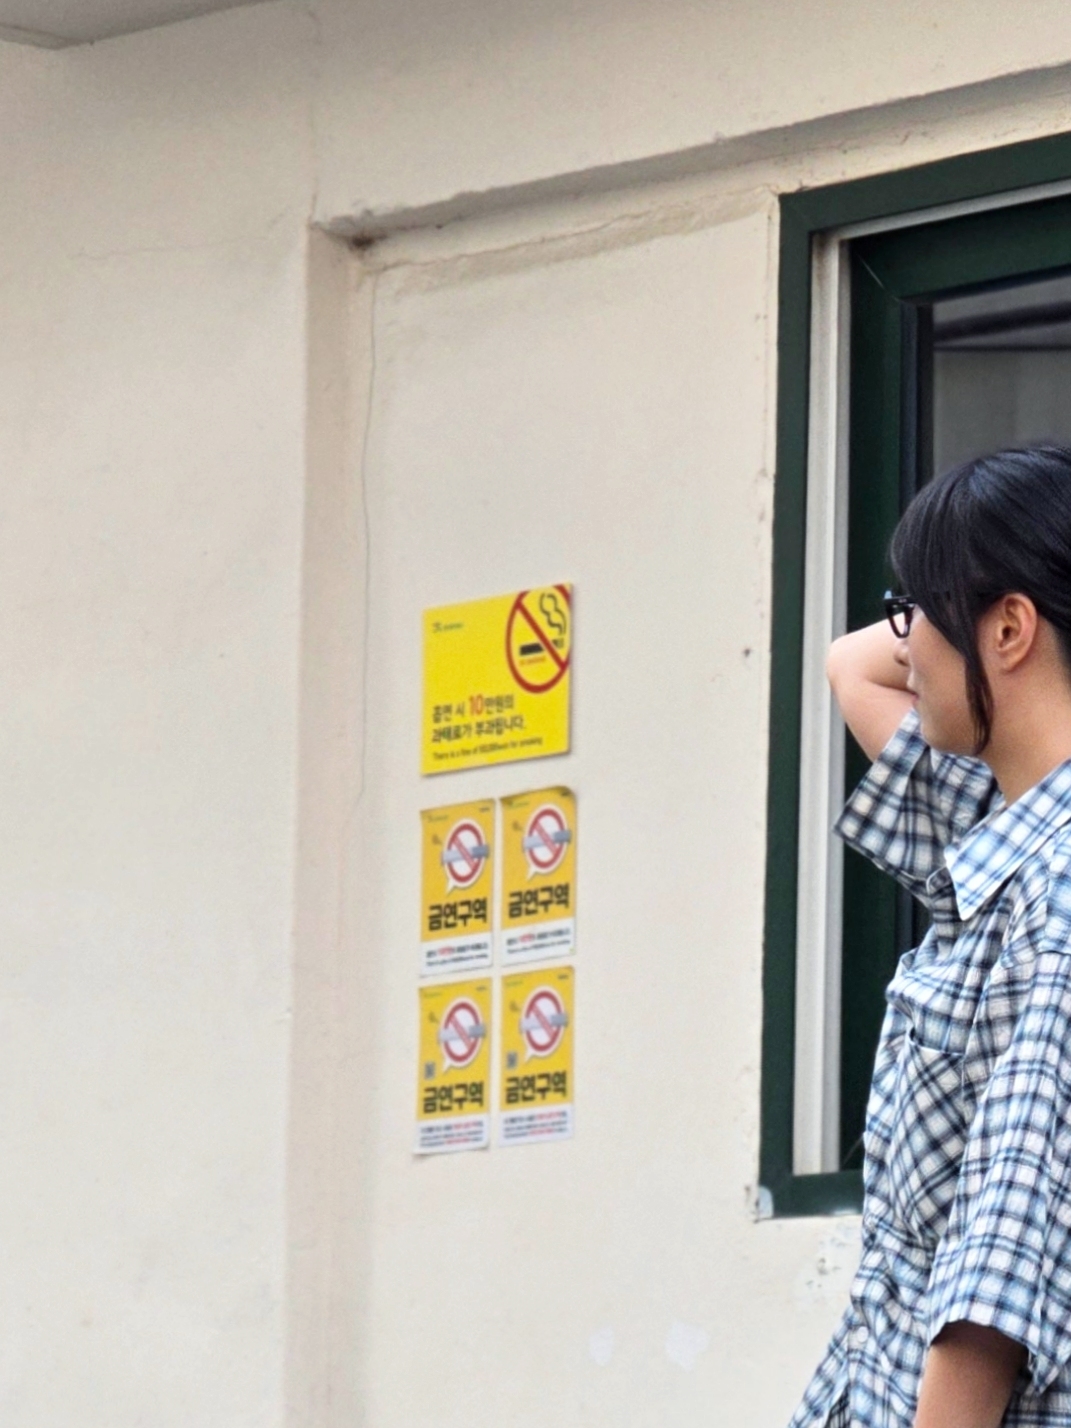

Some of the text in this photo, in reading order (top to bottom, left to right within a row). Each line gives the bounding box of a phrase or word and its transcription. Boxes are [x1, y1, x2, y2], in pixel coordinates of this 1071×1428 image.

[428, 897, 488, 931] 금연구역
[508, 882, 570, 919] 금연구역
[423, 1080, 484, 1114] 금연구역
[505, 1070, 567, 1104] 금연구역
